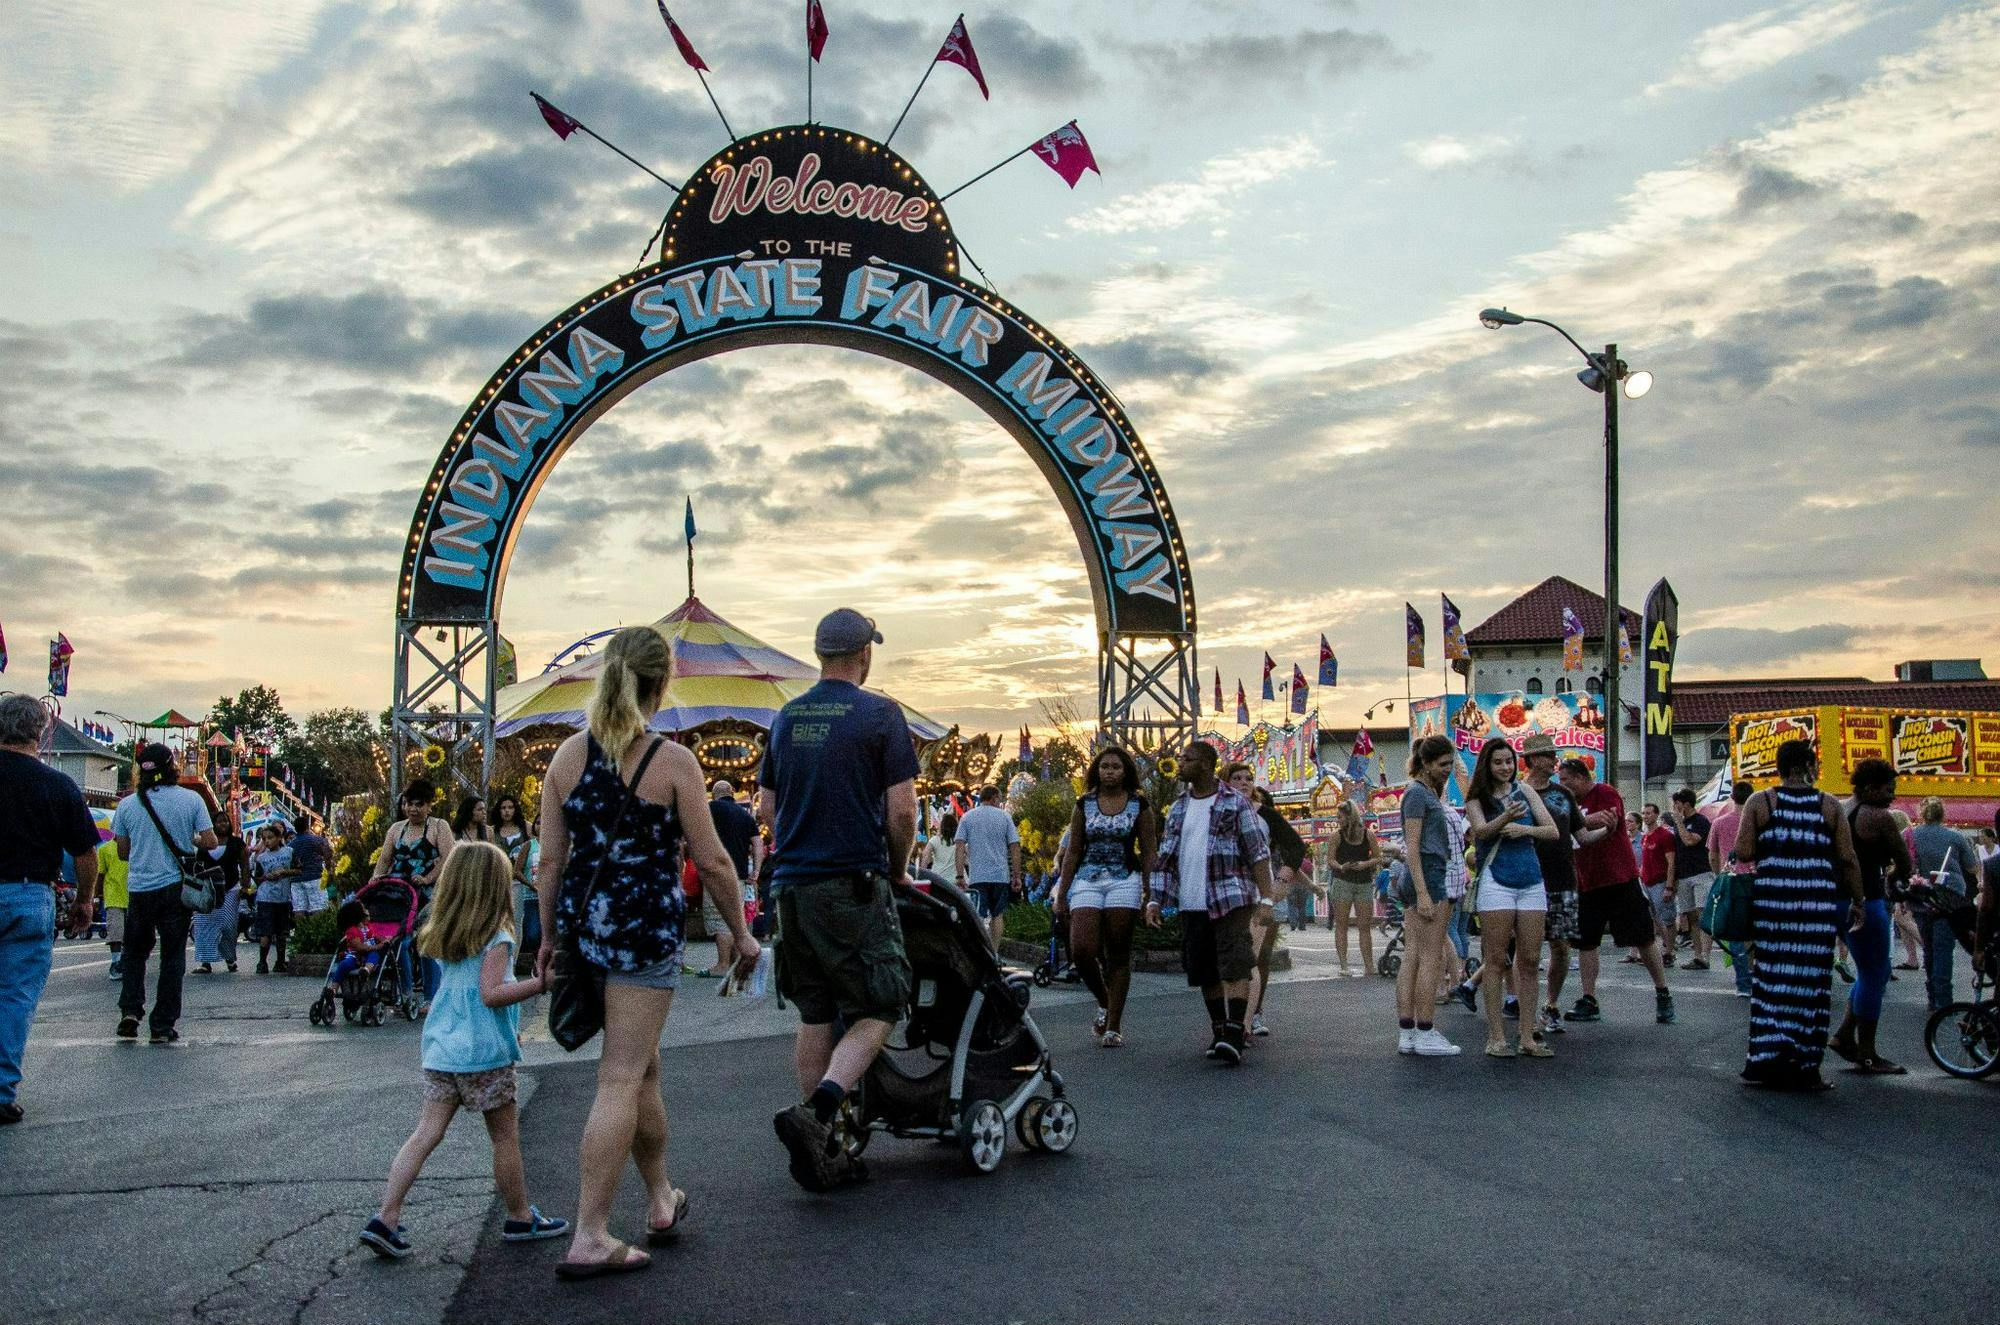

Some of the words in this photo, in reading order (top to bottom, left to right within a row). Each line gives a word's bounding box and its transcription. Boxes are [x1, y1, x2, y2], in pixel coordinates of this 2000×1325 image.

[709, 153, 929, 232] Welcome
[760, 239, 791, 255] TO
[805, 239, 852, 257] THE
[424, 325, 625, 590] INDIANA
[630, 258, 823, 349] STATE
[840, 265, 1004, 367] FAIR
[996, 351, 1176, 604] MIDWAY
[1647, 620, 1674, 736] ATM
[1455, 728, 1536, 754] Fune
[1748, 722, 1771, 740] HOT
[1899, 728, 1956, 753] WISCONSIN
[1905, 720, 1929, 737] HOT
[1917, 742, 1954, 762] CHEESE
